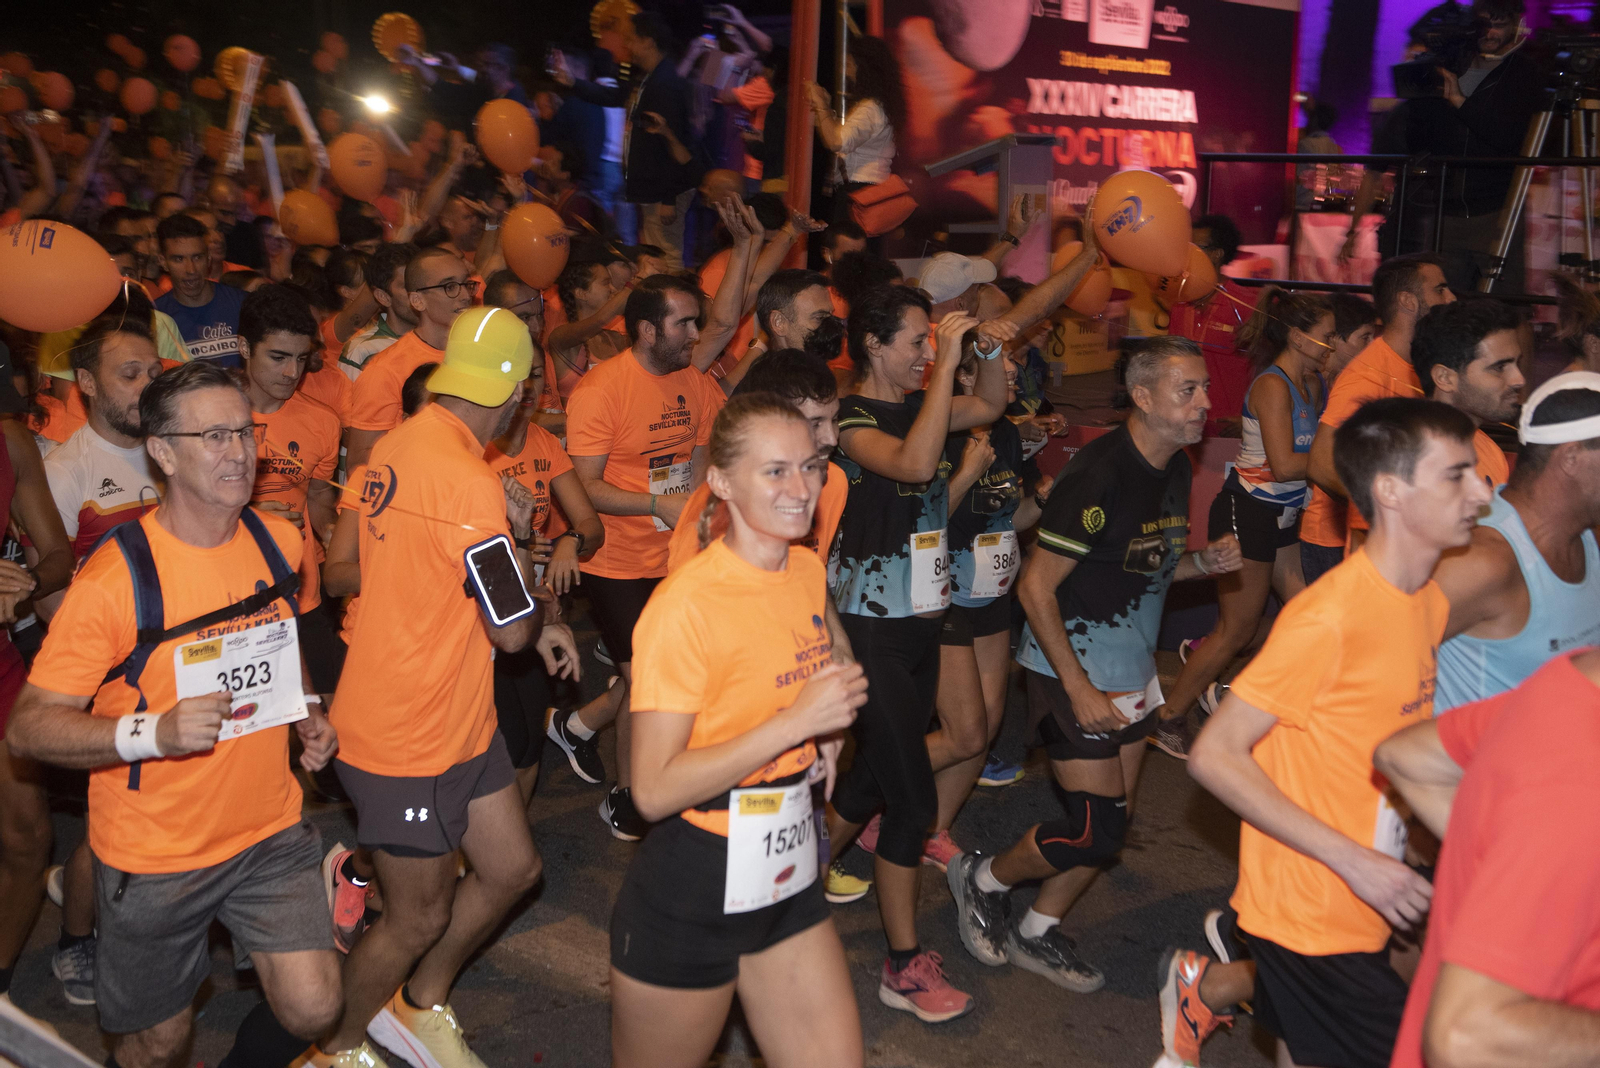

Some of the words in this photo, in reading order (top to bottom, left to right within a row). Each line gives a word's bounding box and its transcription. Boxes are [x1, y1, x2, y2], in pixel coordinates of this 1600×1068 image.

[1101, 84, 1198, 123] CARRERA
[1028, 125, 1197, 168] OCTURNA
[202, 322, 233, 340] Cafés
[649, 420, 676, 432] SEVILLA
[661, 410, 691, 421] NOCTURNA
[216, 660, 272, 694] 3523
[763, 814, 812, 858] 15207
